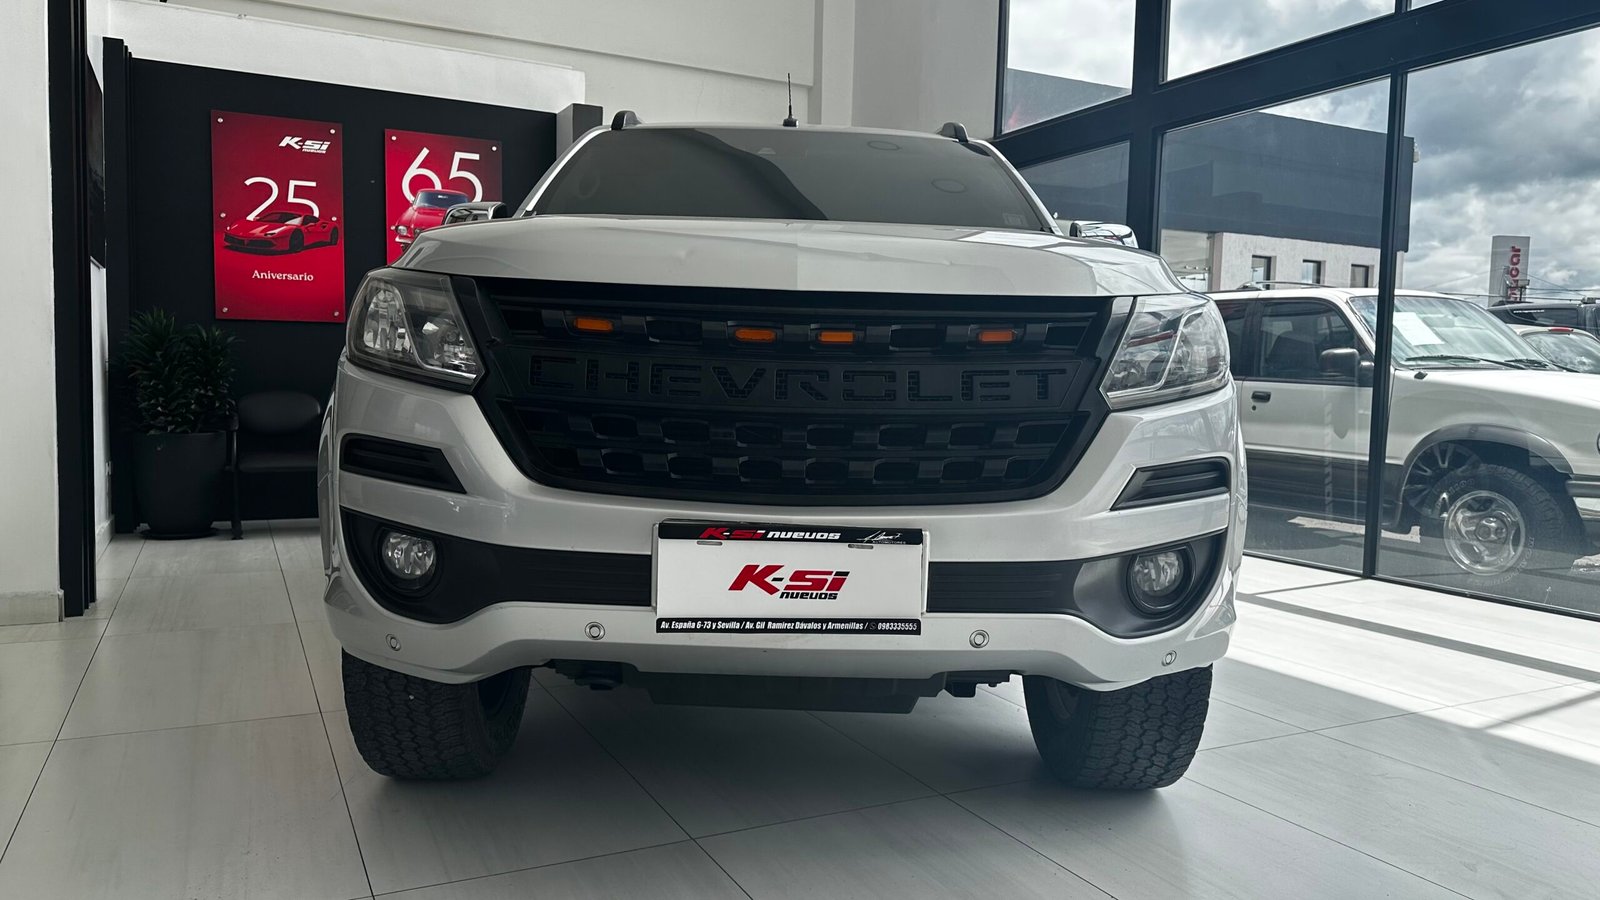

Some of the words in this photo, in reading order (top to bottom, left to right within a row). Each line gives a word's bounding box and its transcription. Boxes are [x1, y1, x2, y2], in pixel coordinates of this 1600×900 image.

[401, 147, 483, 203] 65
[244, 177, 320, 221] 25
[252, 270, 314, 282] Aniversario
[528, 354, 1068, 403] CHEVROLET
[660, 621, 670, 629] Av.
[671, 621, 695, 630] España
[696, 621, 711, 629] 6-73
[717, 621, 740, 629] Sevilla
[745, 621, 755, 629] Av.
[795, 621, 821, 630] Dávalos
[827, 621, 863, 630] Armenillas
[877, 622, 917, 631] 0983335555
